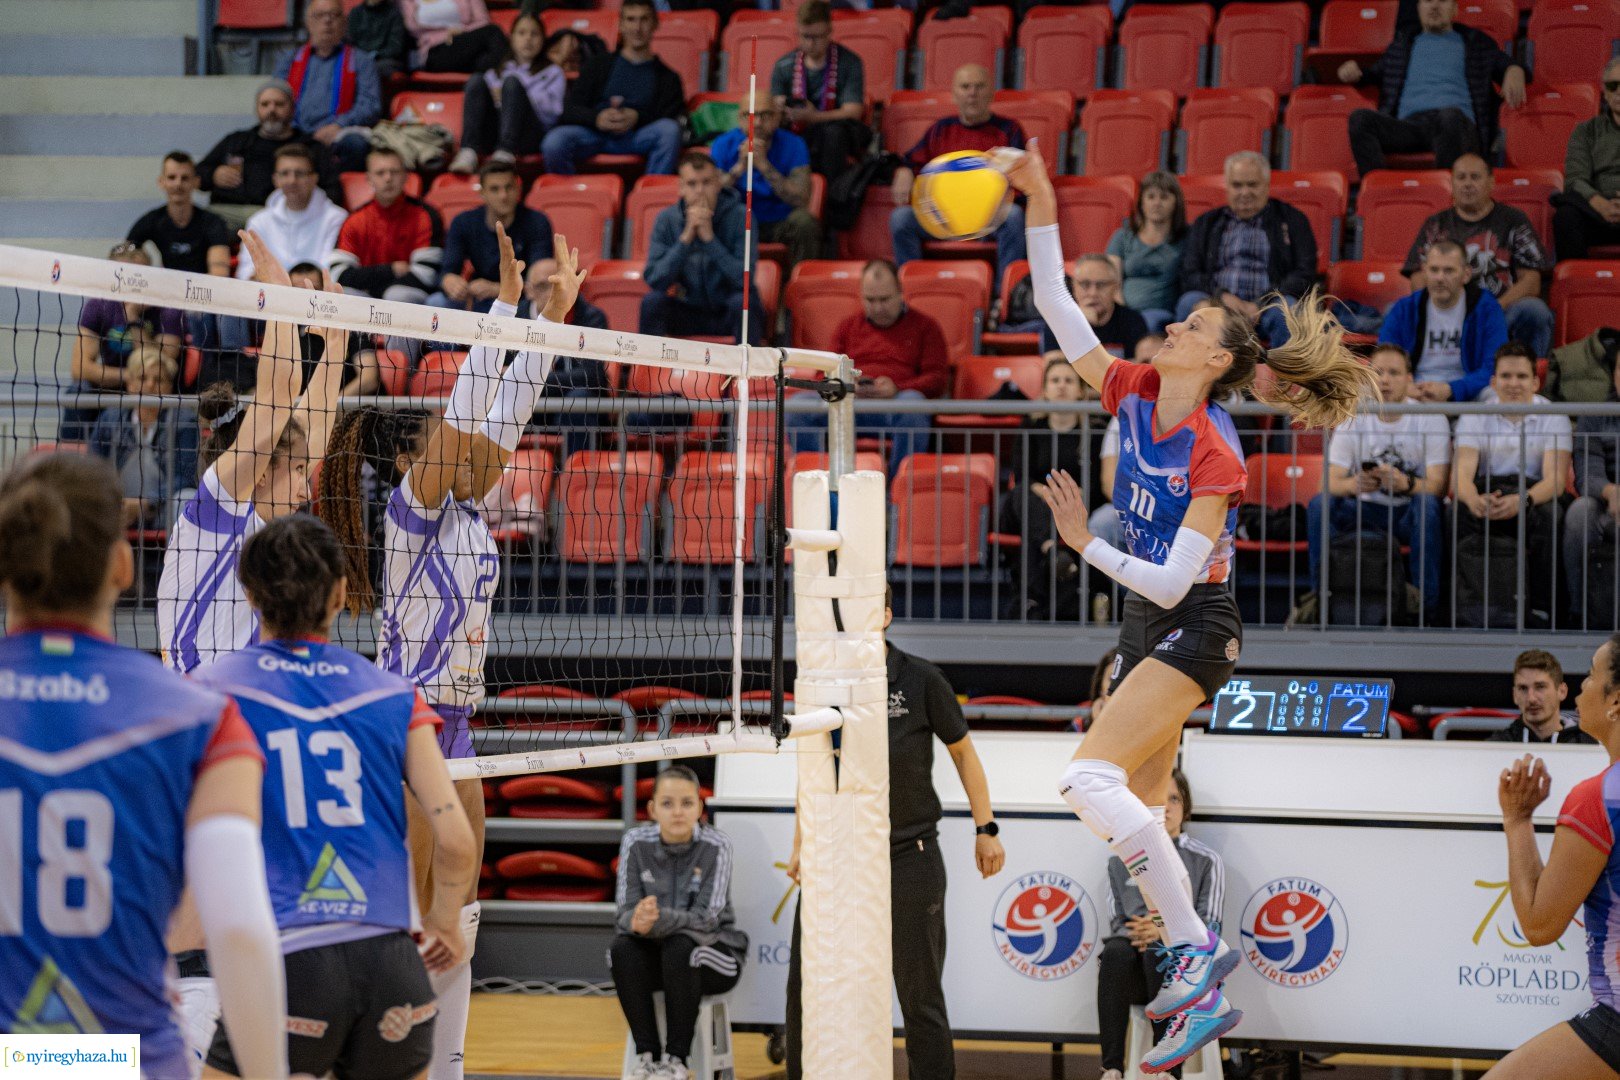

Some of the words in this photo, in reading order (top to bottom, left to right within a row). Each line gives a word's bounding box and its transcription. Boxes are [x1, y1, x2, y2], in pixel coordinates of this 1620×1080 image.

[185, 279, 212, 301] FATUM
[368, 304, 392, 325] FATUM
[1129, 482, 1156, 522] 10
[475, 553, 499, 602] 2
[1333, 683, 1389, 697] FATUM
[1228, 695, 1256, 728] 2
[1342, 698, 1370, 731] 2
[267, 728, 365, 829] 13
[0, 788, 115, 939] 18
[1019, 874, 1071, 891] FATUM
[1268, 880, 1321, 897] FATUM
[1503, 953, 1552, 965] MAGYAR
[1496, 991, 1560, 1007] SZÖVETSÉG
